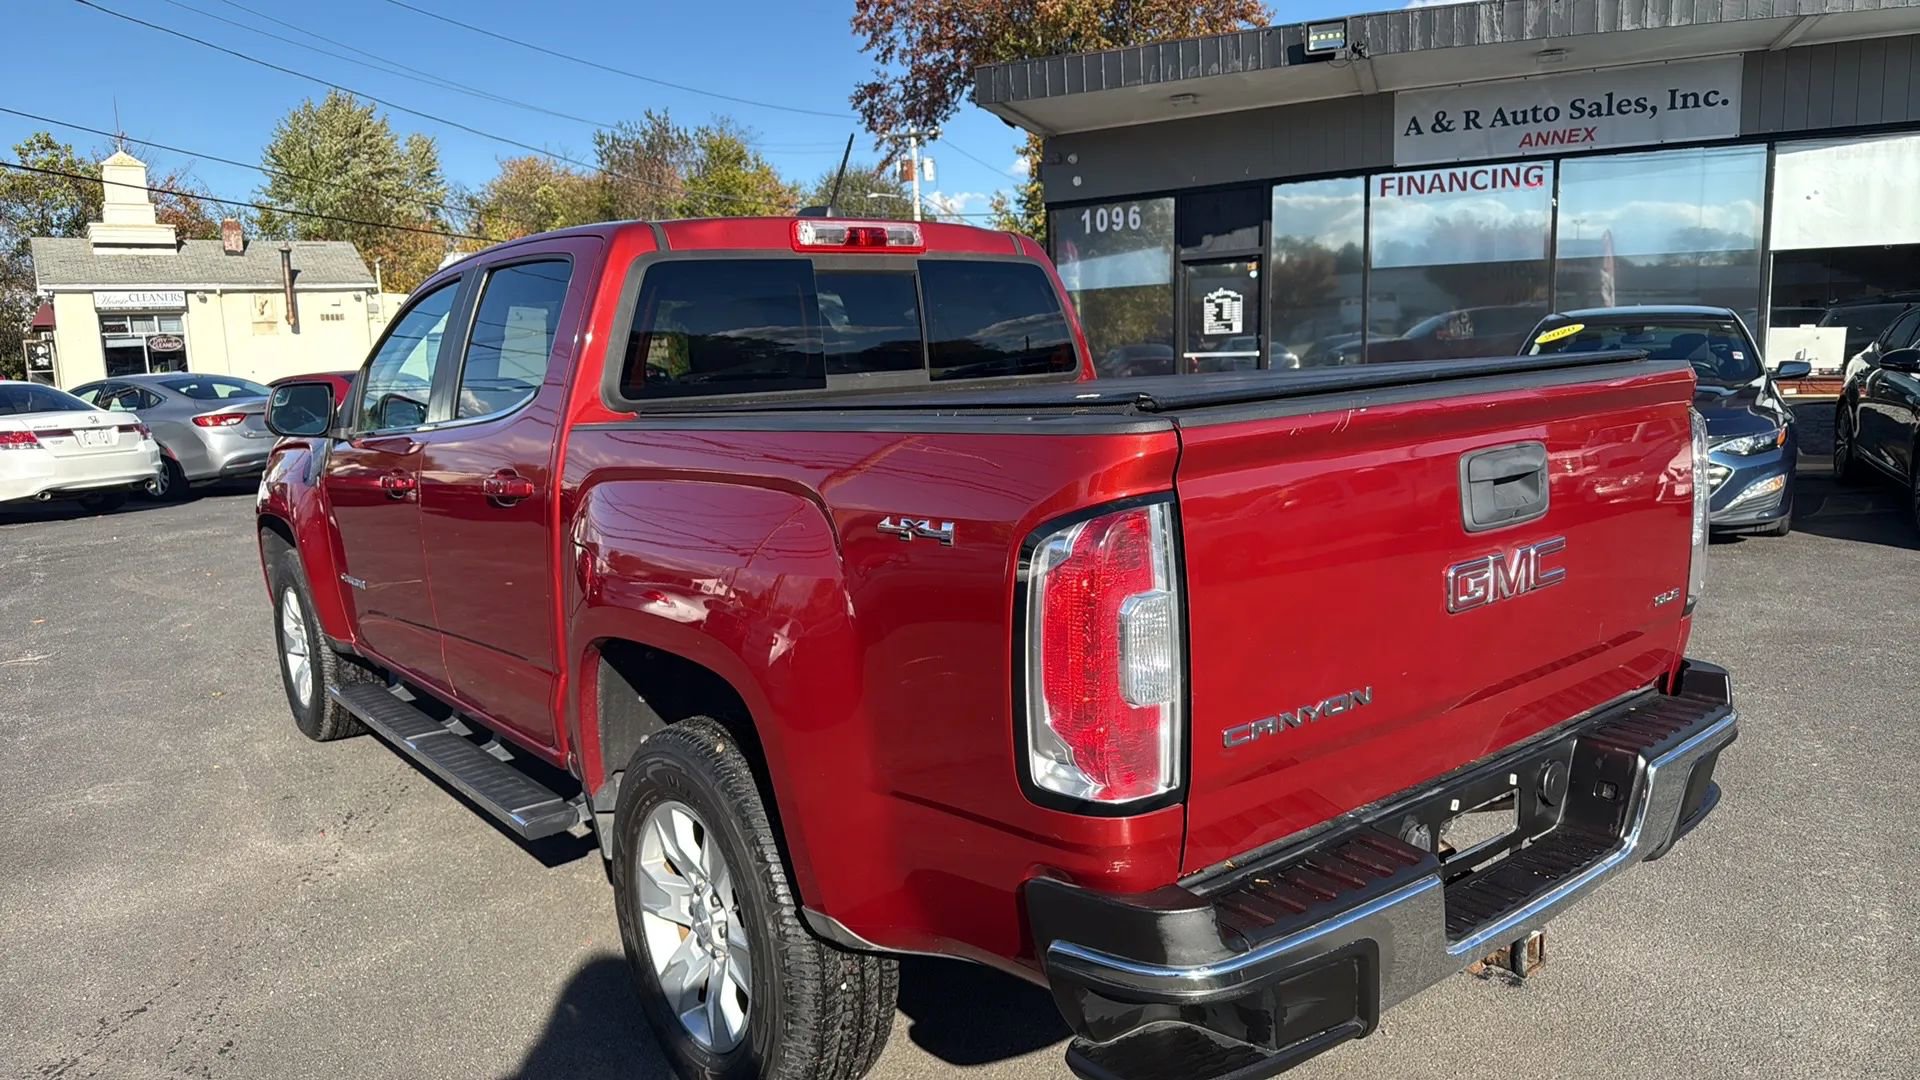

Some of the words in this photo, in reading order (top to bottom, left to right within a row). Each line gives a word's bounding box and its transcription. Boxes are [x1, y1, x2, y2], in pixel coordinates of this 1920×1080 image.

[1403, 115, 1425, 137] A
[1430, 110, 1456, 134] &
[1462, 109, 1483, 131] R
[1489, 103, 1561, 128] Auto
[1568, 91, 1658, 120] Sales,
[1666, 88, 1729, 111] Inc.
[1518, 125, 1598, 149] ANNEX
[1380, 165, 1544, 198] FINANCING
[1081, 205, 1141, 234] 1096
[128, 292, 184, 303] CLEANERS
[1446, 535, 1567, 615] GMC
[1221, 685, 1373, 748] CANYON
